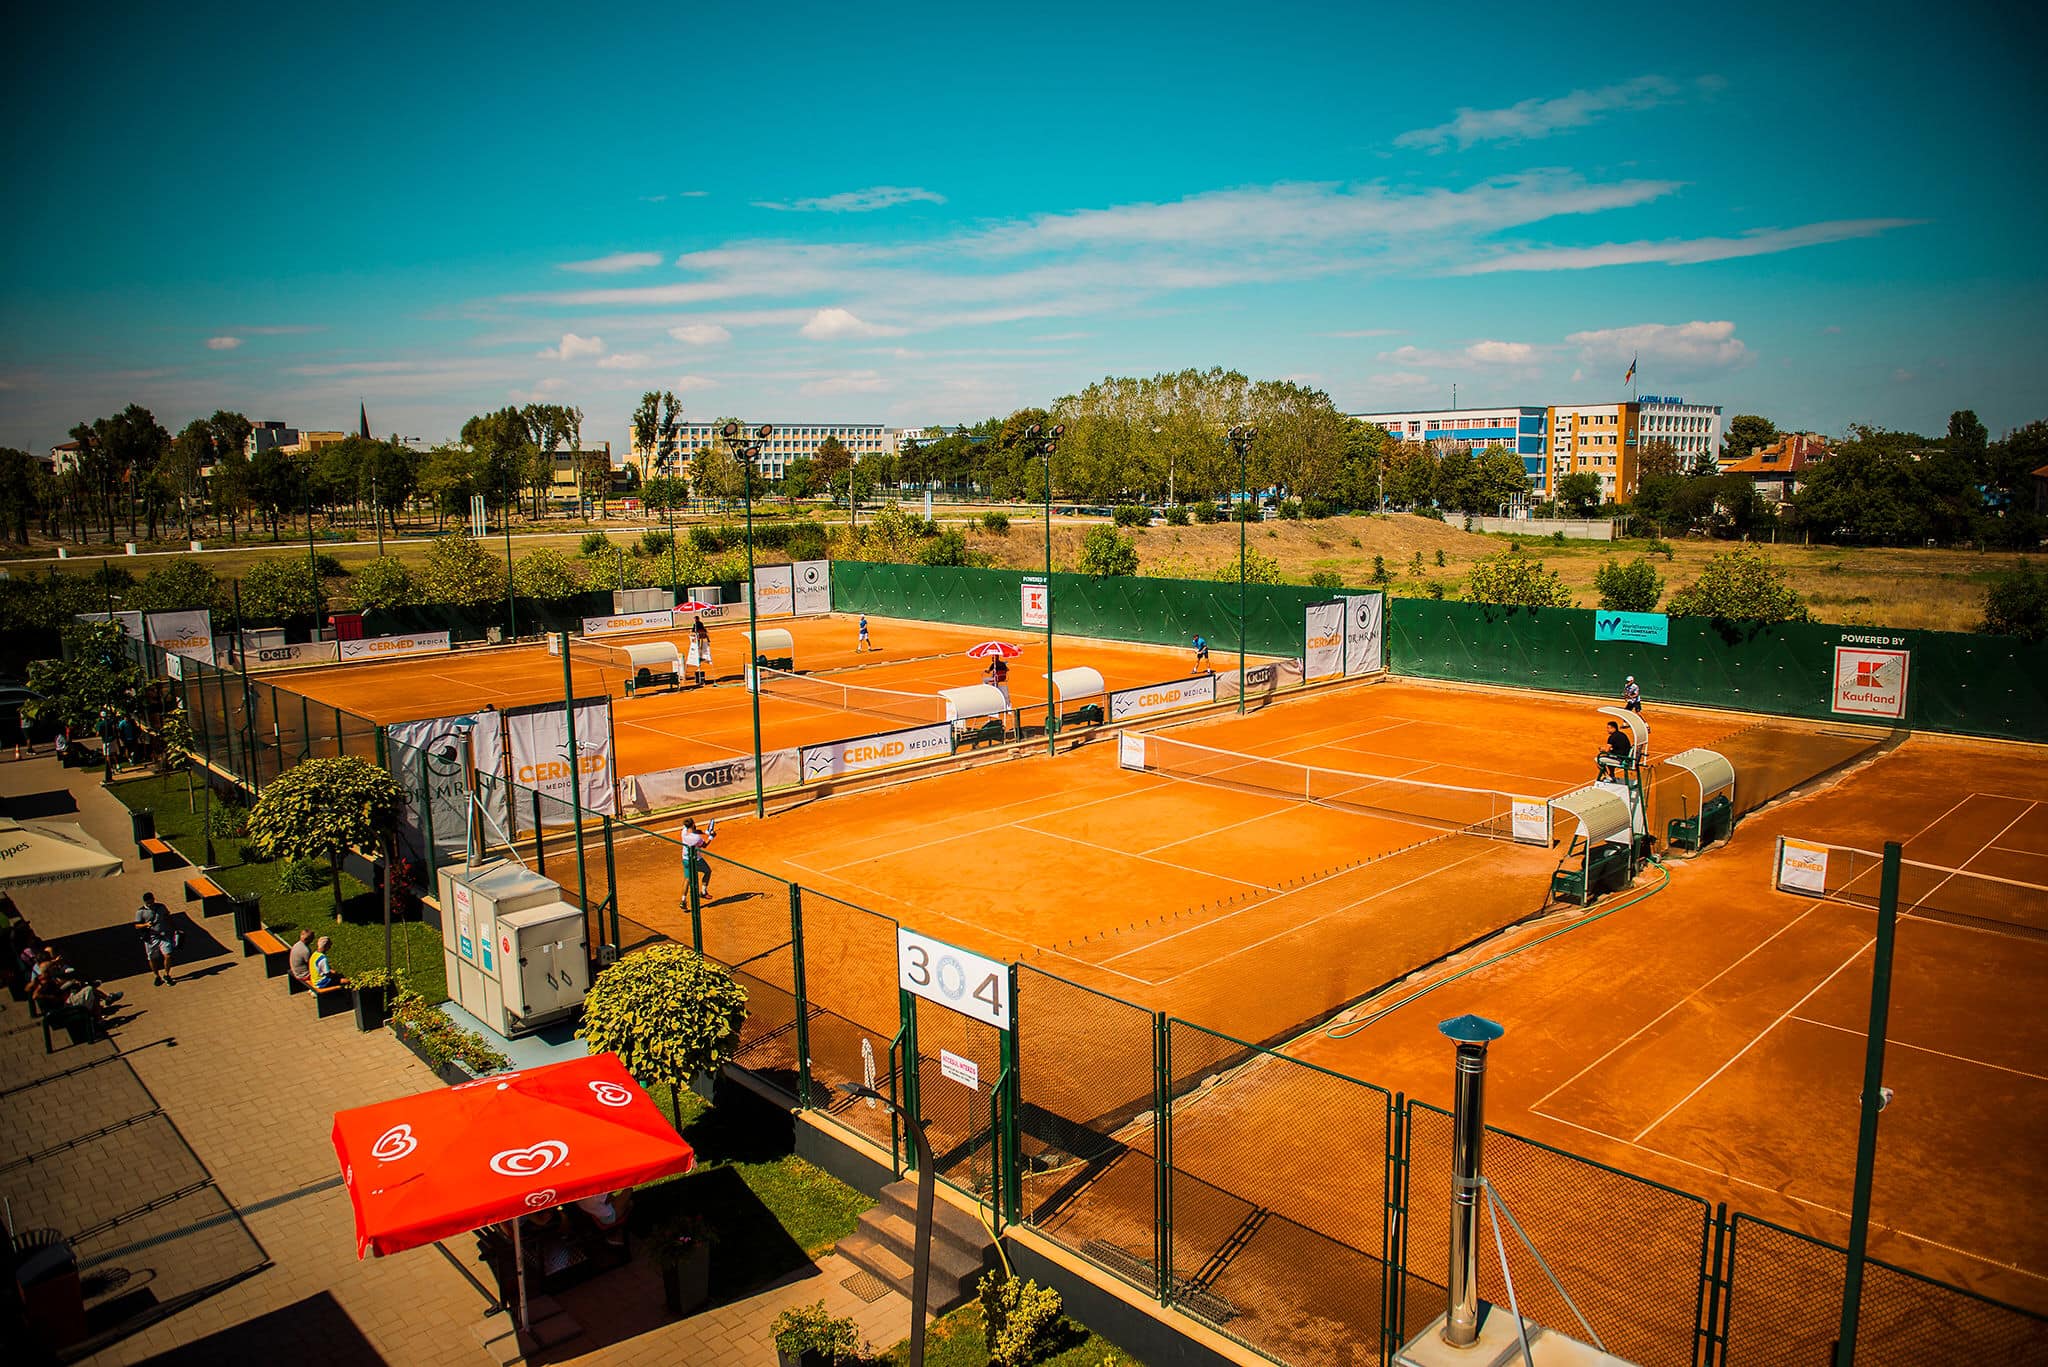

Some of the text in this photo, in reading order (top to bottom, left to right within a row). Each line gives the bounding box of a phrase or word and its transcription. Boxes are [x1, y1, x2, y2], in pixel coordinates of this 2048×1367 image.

[758, 586, 790, 595] CERMED
[702, 607, 723, 617] OCH
[606, 617, 644, 628] CERMED
[368, 638, 448, 652] CERMED MEDICAL
[1307, 632, 1342, 649] CERMED
[1841, 634, 1905, 646] POWERED BY
[260, 648, 291, 660] OCH
[1138, 688, 1211, 707] CERMED MEDICAL
[1842, 691, 1896, 704] Kaufland
[842, 737, 949, 764] CERMED MEDICAL
[518, 754, 607, 783] CERMED
[687, 767, 729, 789] OCH
[1785, 857, 1824, 872] CERMED
